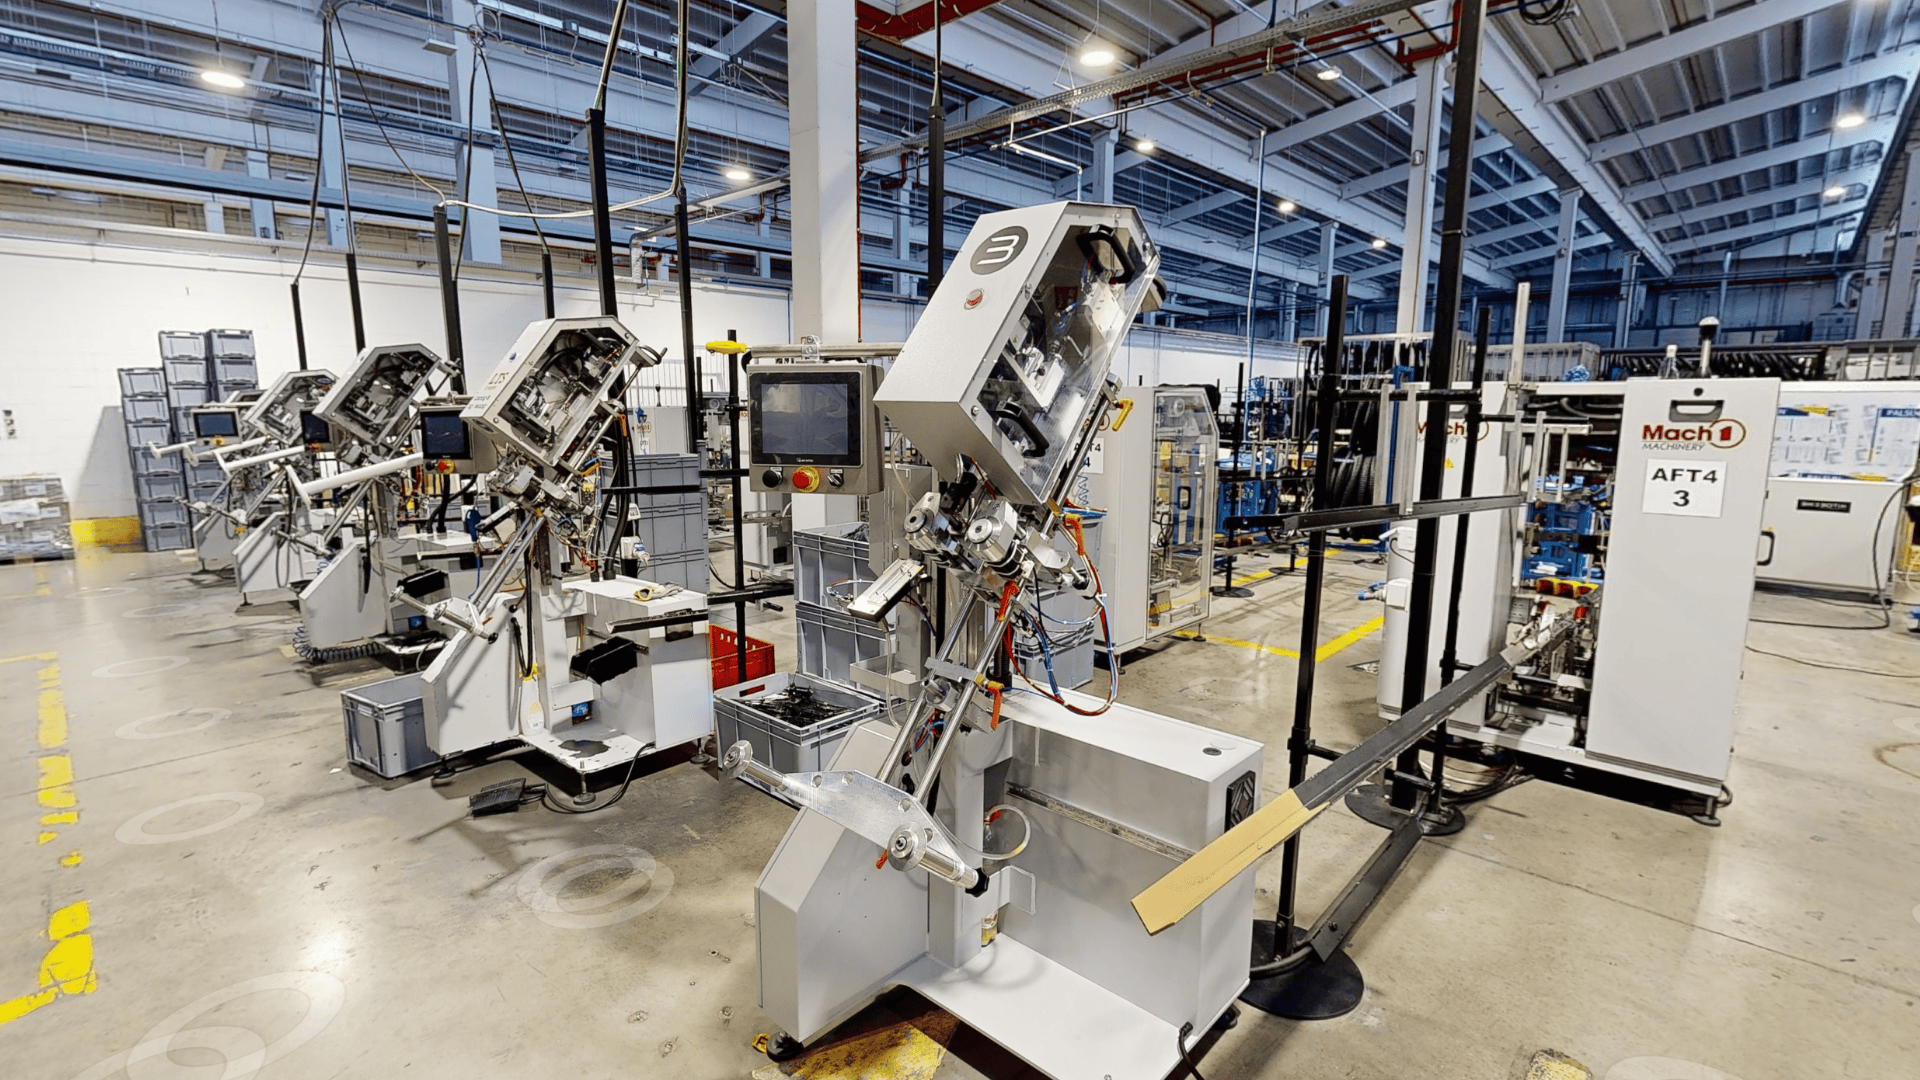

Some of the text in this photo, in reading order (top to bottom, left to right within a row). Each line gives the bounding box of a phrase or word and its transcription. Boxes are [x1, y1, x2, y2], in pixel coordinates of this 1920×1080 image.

[1642, 425, 1712, 441] Mach
[1073, 442, 1101, 452] AT4
[1642, 442, 1706, 451] MACHINERY
[1651, 468, 1718, 484] AFT4
[1672, 489, 1690, 507] 3
